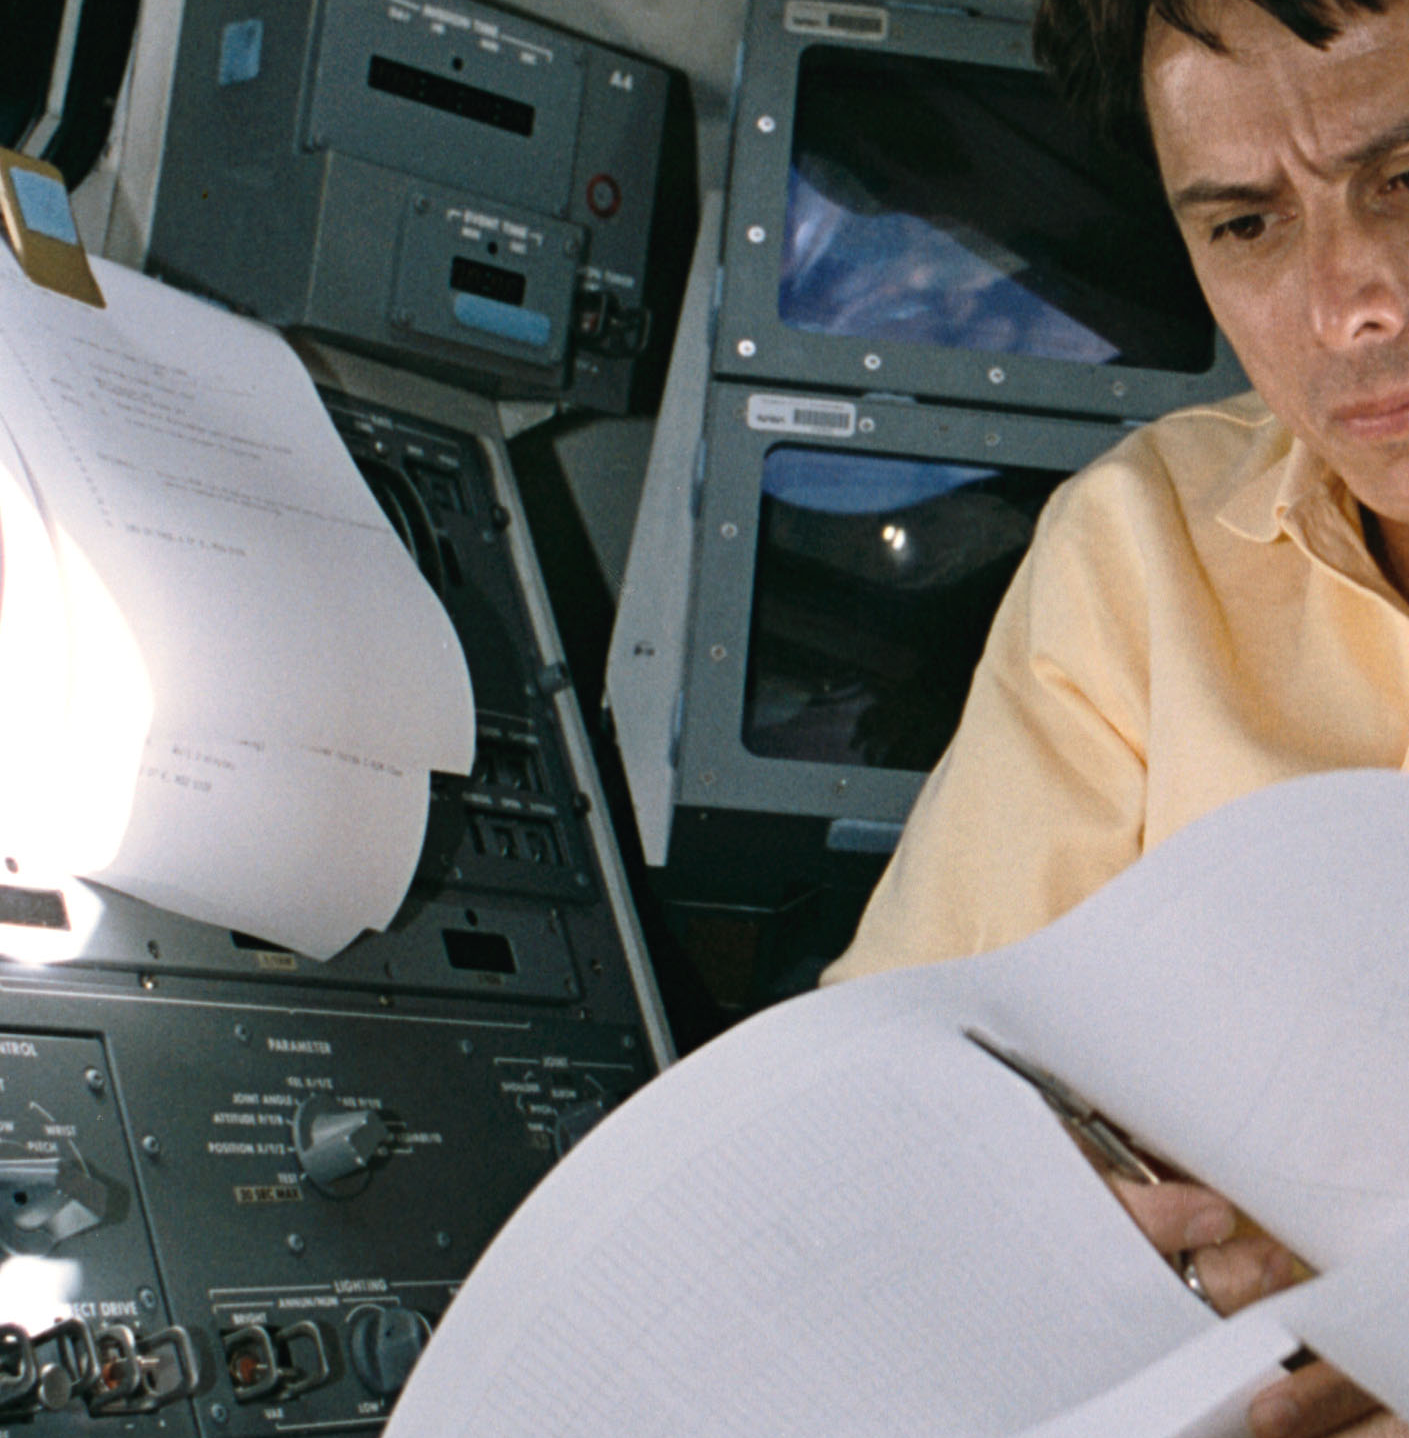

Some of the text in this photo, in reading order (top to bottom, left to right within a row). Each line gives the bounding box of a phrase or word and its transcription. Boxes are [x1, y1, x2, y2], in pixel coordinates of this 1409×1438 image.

[267, 1038, 332, 1054] PARAMETER
[208, 1142, 253, 1154] POSITION
[276, 1187, 299, 1200] MAX
[334, 1278, 388, 1294] LIGHTING
[101, 1301, 138, 1316] DRIVE
